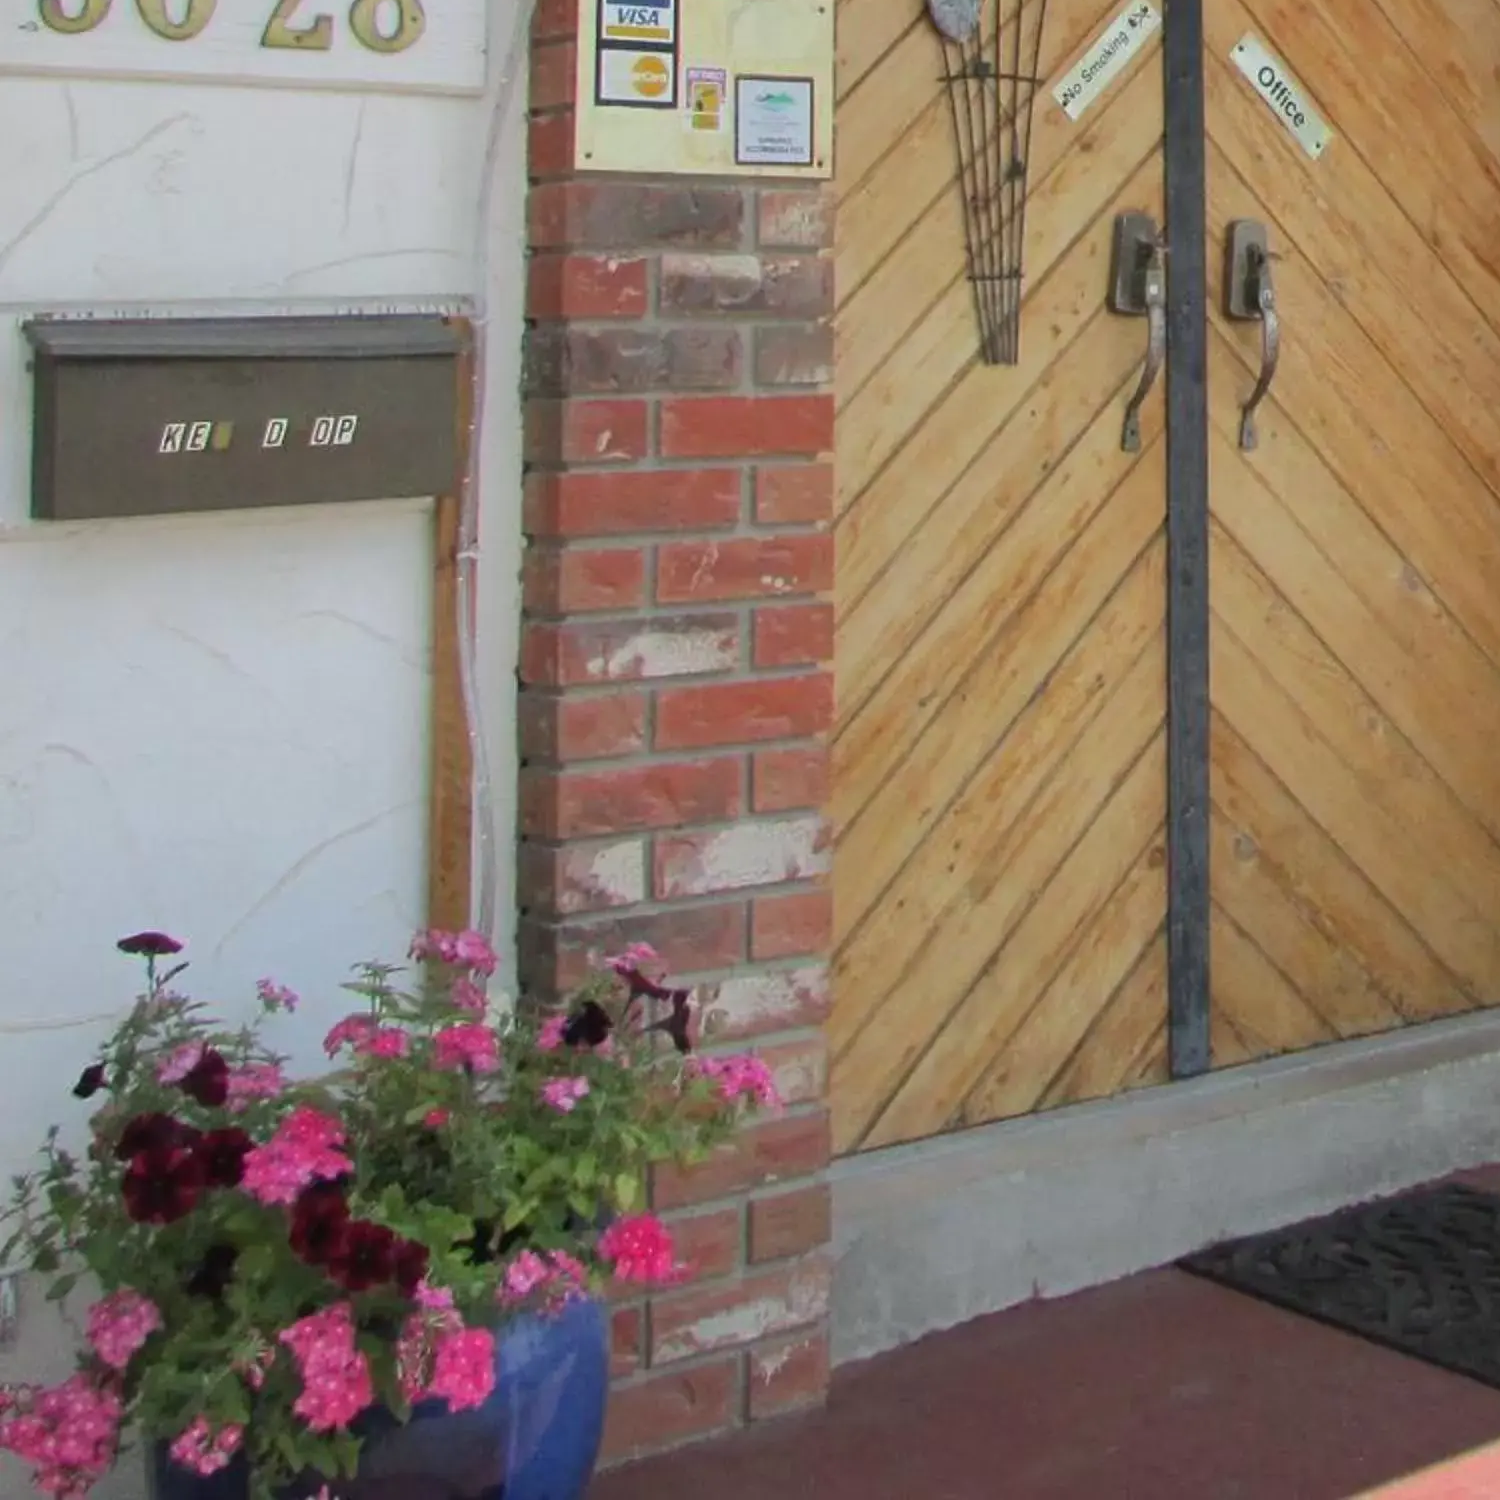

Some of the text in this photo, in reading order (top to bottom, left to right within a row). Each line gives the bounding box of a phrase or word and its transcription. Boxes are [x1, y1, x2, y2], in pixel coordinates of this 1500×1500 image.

[617, 7, 660, 26] VISA
[1062, 30, 1130, 106] No Smoking
[1257, 65, 1305, 128] Office
[160, 422, 232, 452] KE
